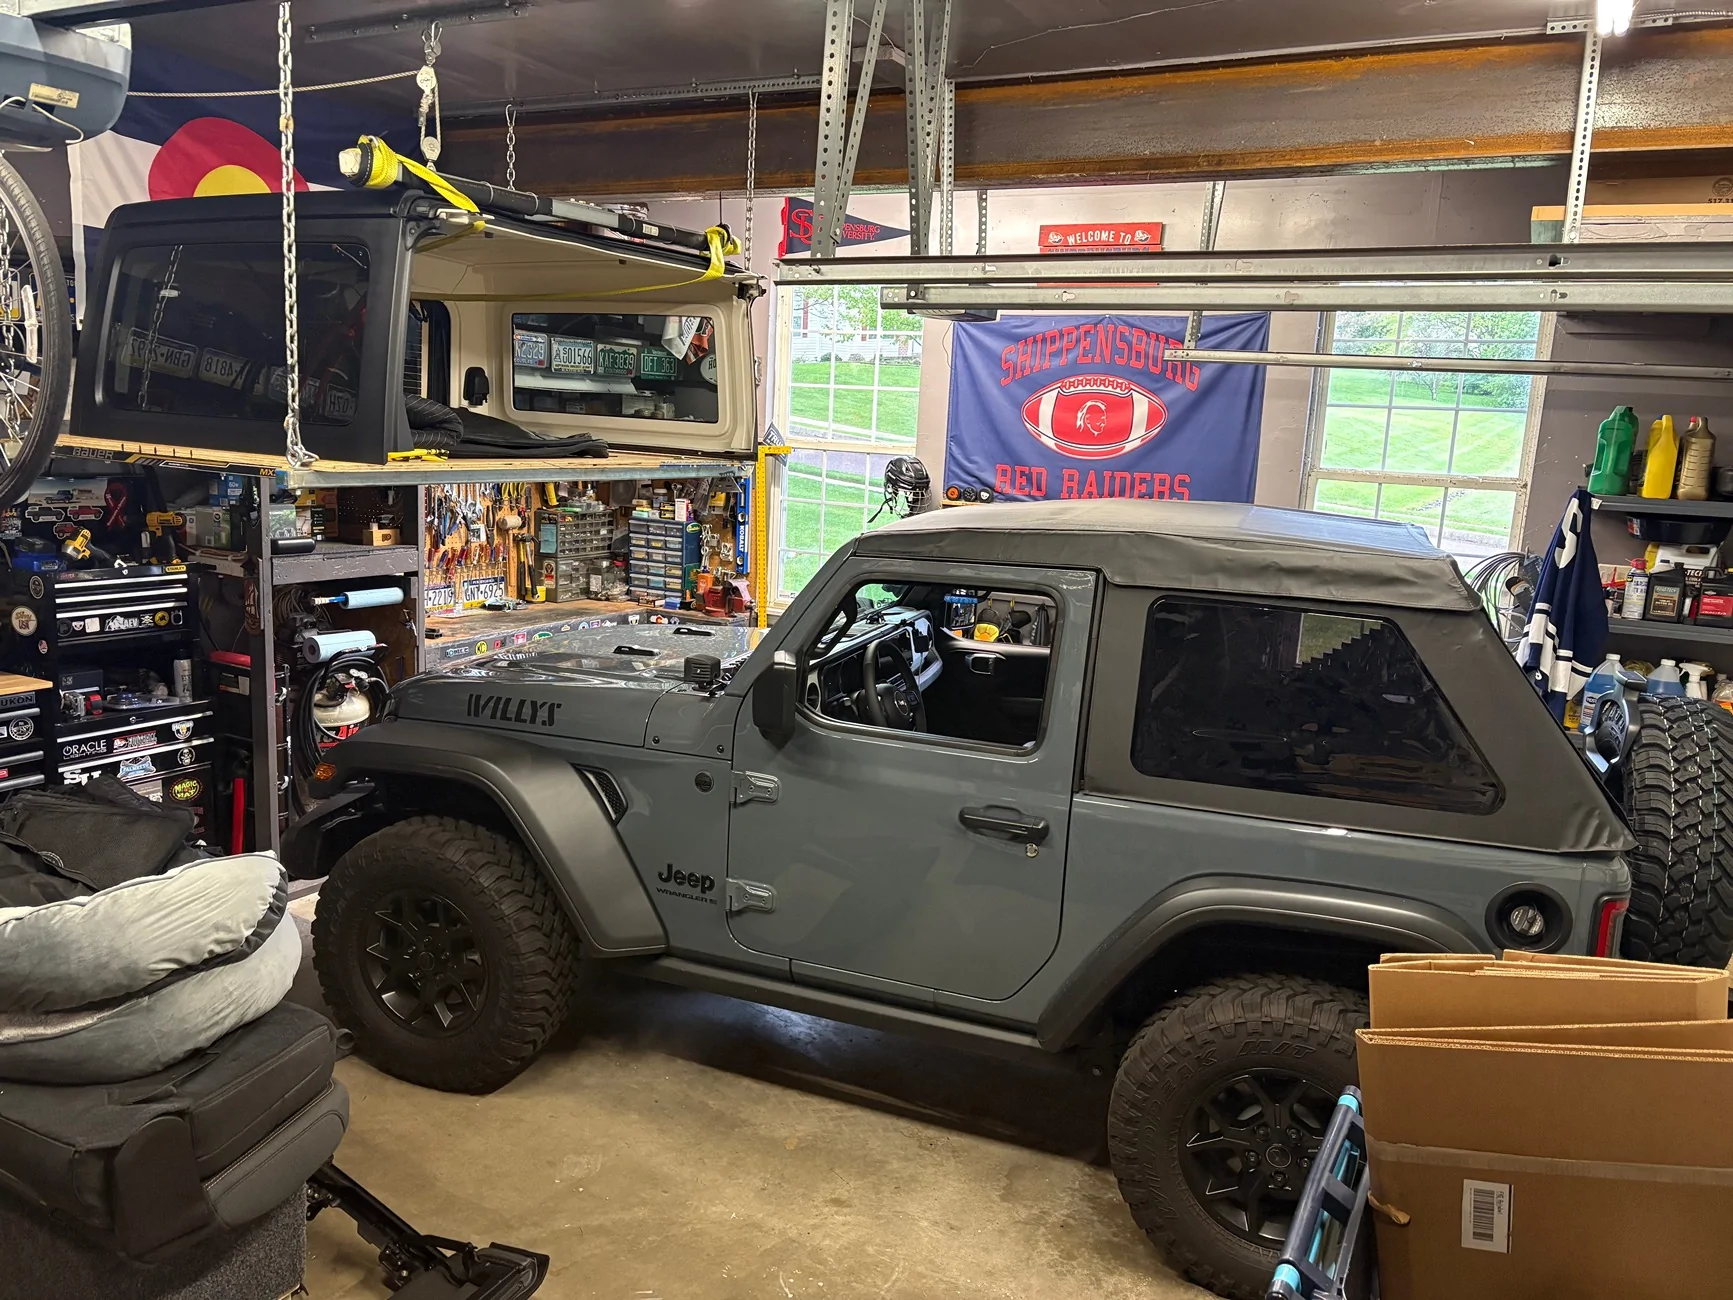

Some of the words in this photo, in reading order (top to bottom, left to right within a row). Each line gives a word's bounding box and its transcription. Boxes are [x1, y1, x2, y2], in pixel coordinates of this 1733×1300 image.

[842, 230, 875, 240] VERSITY.
[843, 223, 880, 233] PENSBURG
[1067, 230, 1116, 246] WELCOME
[1119, 232, 1132, 245] TO
[599, 352, 635, 369] KAF3839
[999, 323, 1202, 392] SHIPPENSBURG
[994, 464, 1048, 497] RED
[1061, 468, 1192, 501] RAIDERS
[0, 695, 33, 707] UKON
[466, 693, 562, 727] WILLYS
[63, 740, 107, 756] ORACLE
[175, 780, 198, 791] MAGIC
[658, 863, 716, 895] Jeep
[656, 886, 708, 903] WRANGLER
